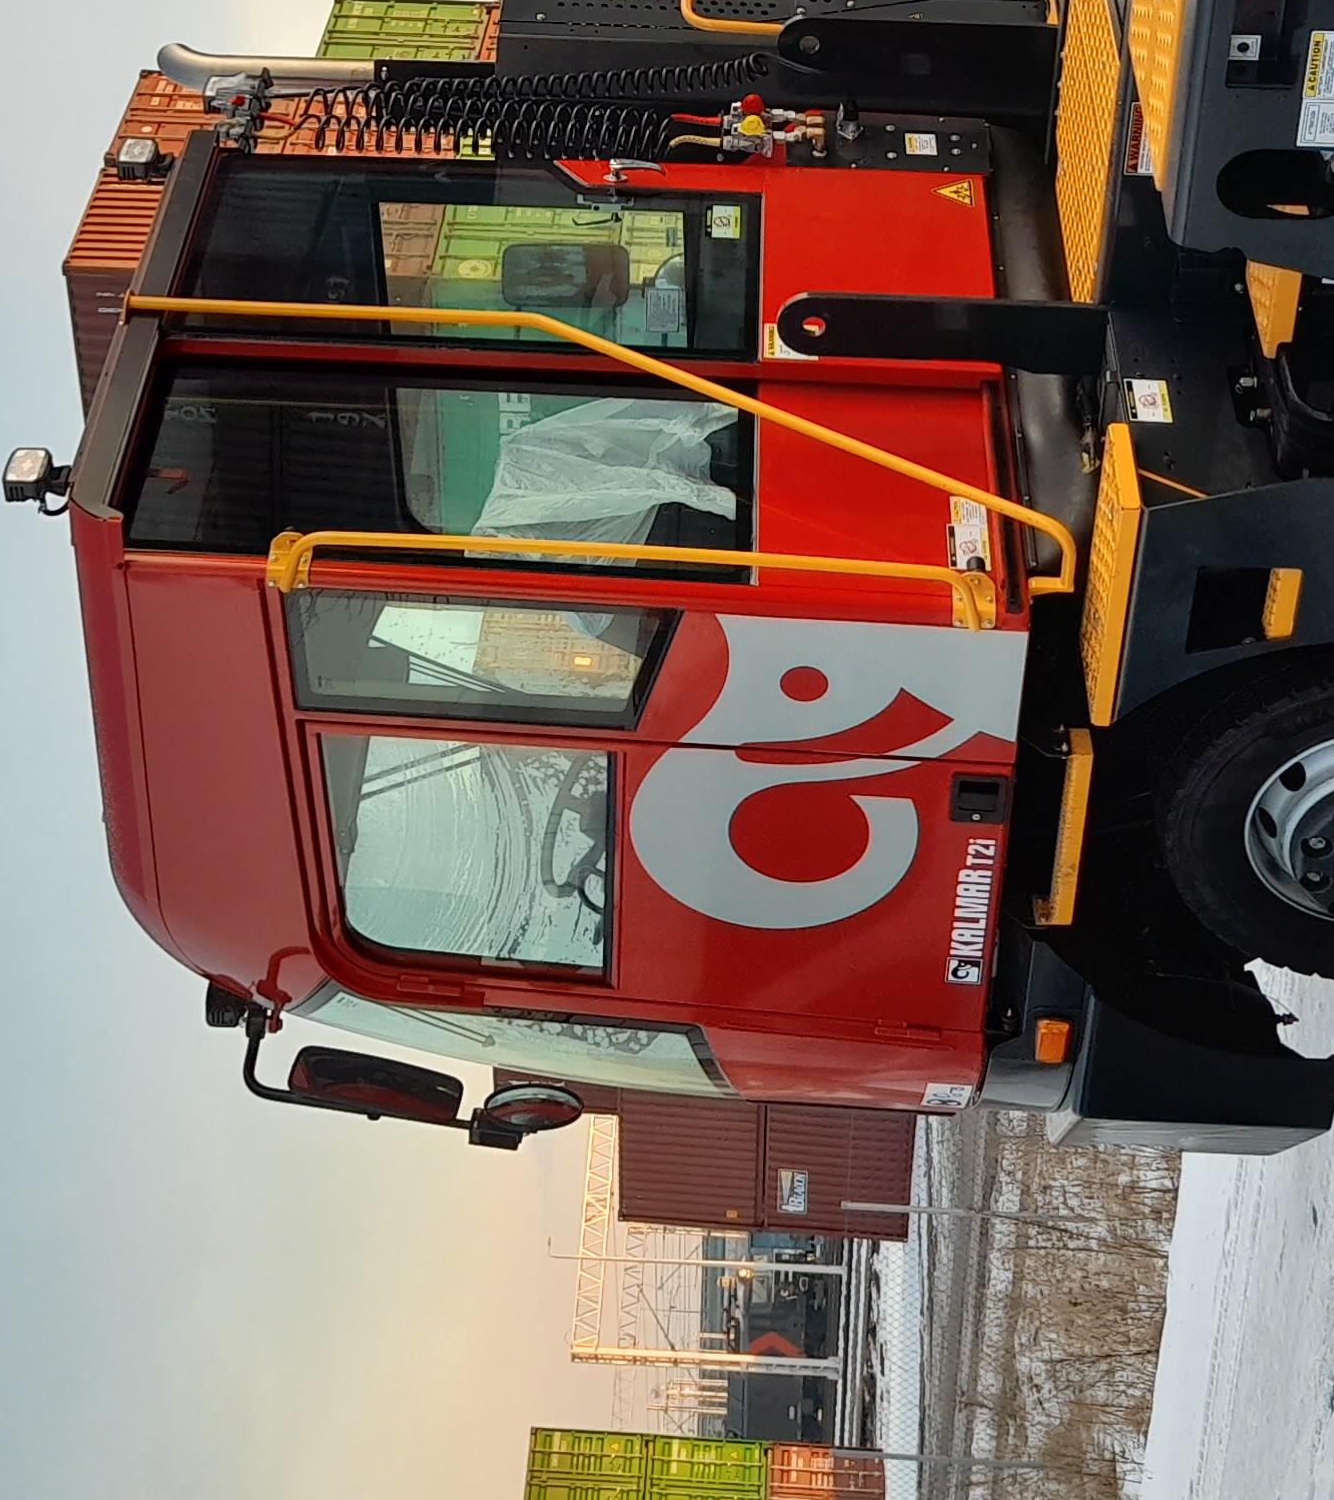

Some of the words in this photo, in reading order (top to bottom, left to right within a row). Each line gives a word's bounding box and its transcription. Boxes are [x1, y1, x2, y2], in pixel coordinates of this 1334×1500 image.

[1308, 40, 1321, 83] CAUTION
[1129, 105, 1144, 161] WARNING
[965, 838, 996, 866] T2i
[949, 868, 993, 957] KALMAR
